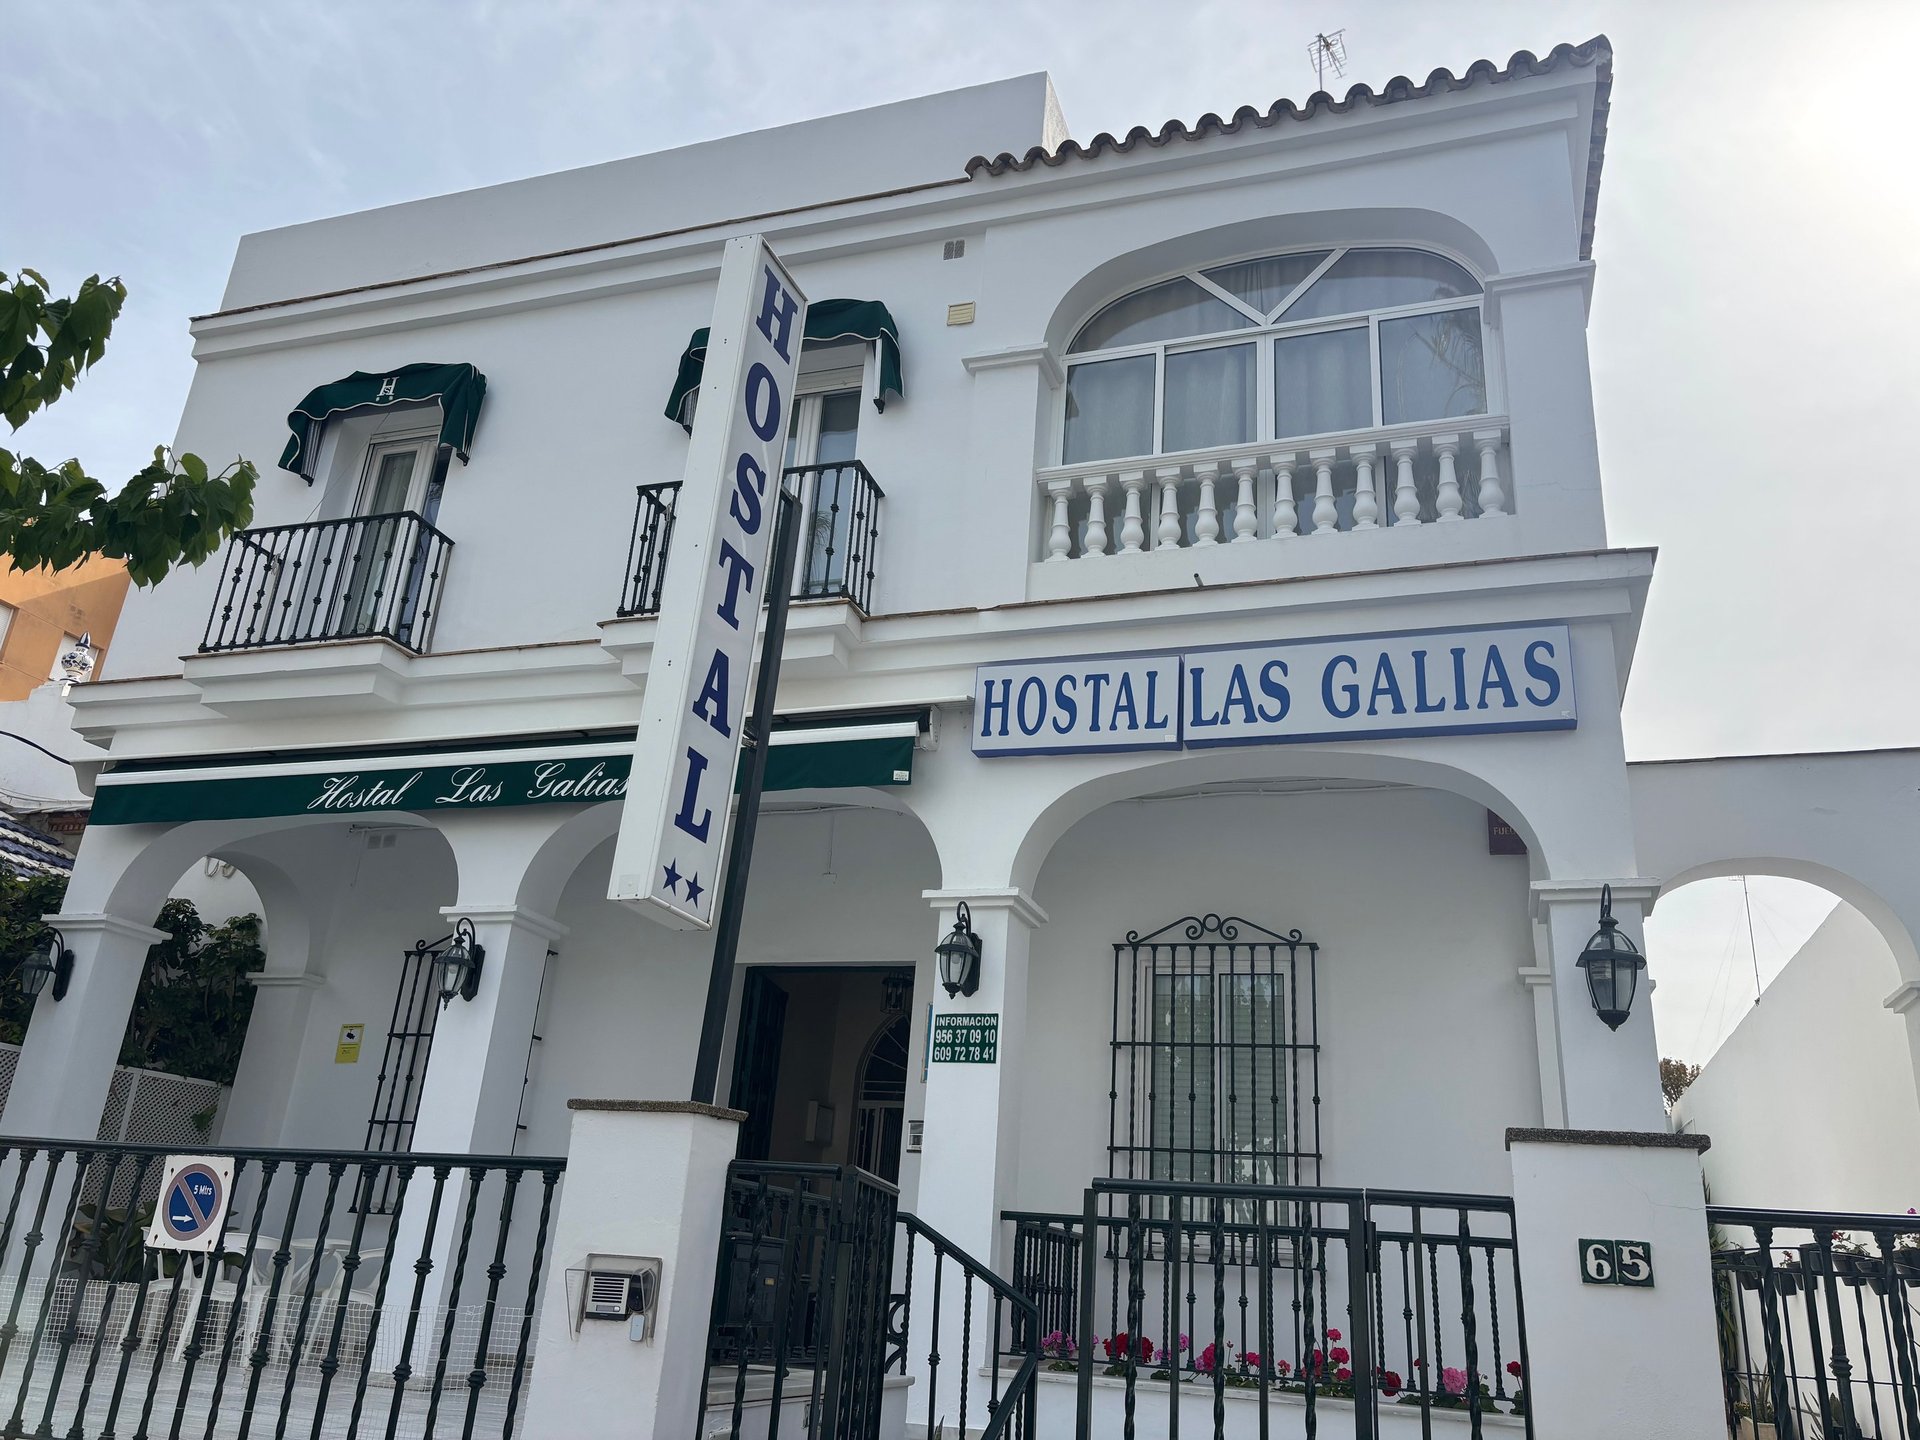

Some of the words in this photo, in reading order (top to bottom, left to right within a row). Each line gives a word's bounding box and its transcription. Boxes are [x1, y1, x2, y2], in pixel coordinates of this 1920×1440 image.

[674, 264, 799, 844] HOSTAL
[980, 671, 1169, 737] HOSTAL
[1189, 659, 1291, 727] LAS
[1321, 640, 1561, 719] GALIAS
[306, 770, 423, 810] Hostal
[434, 767, 503, 804] Las
[526, 761, 629, 799] Galias
[934, 1046, 952, 1061] 609
[954, 1046, 966, 1061] 72
[968, 1046, 981, 1061] 78
[982, 1046, 995, 1061] 41
[935, 1029, 953, 1044] 956
[955, 1029, 968, 1044] 37
[969, 1029, 982, 1044] 09
[984, 1029, 996, 1044] 10
[193, 1184, 200, 1195] 5
[199, 1185, 213, 1196] Mtrs
[1586, 1243, 1650, 1281] 65
